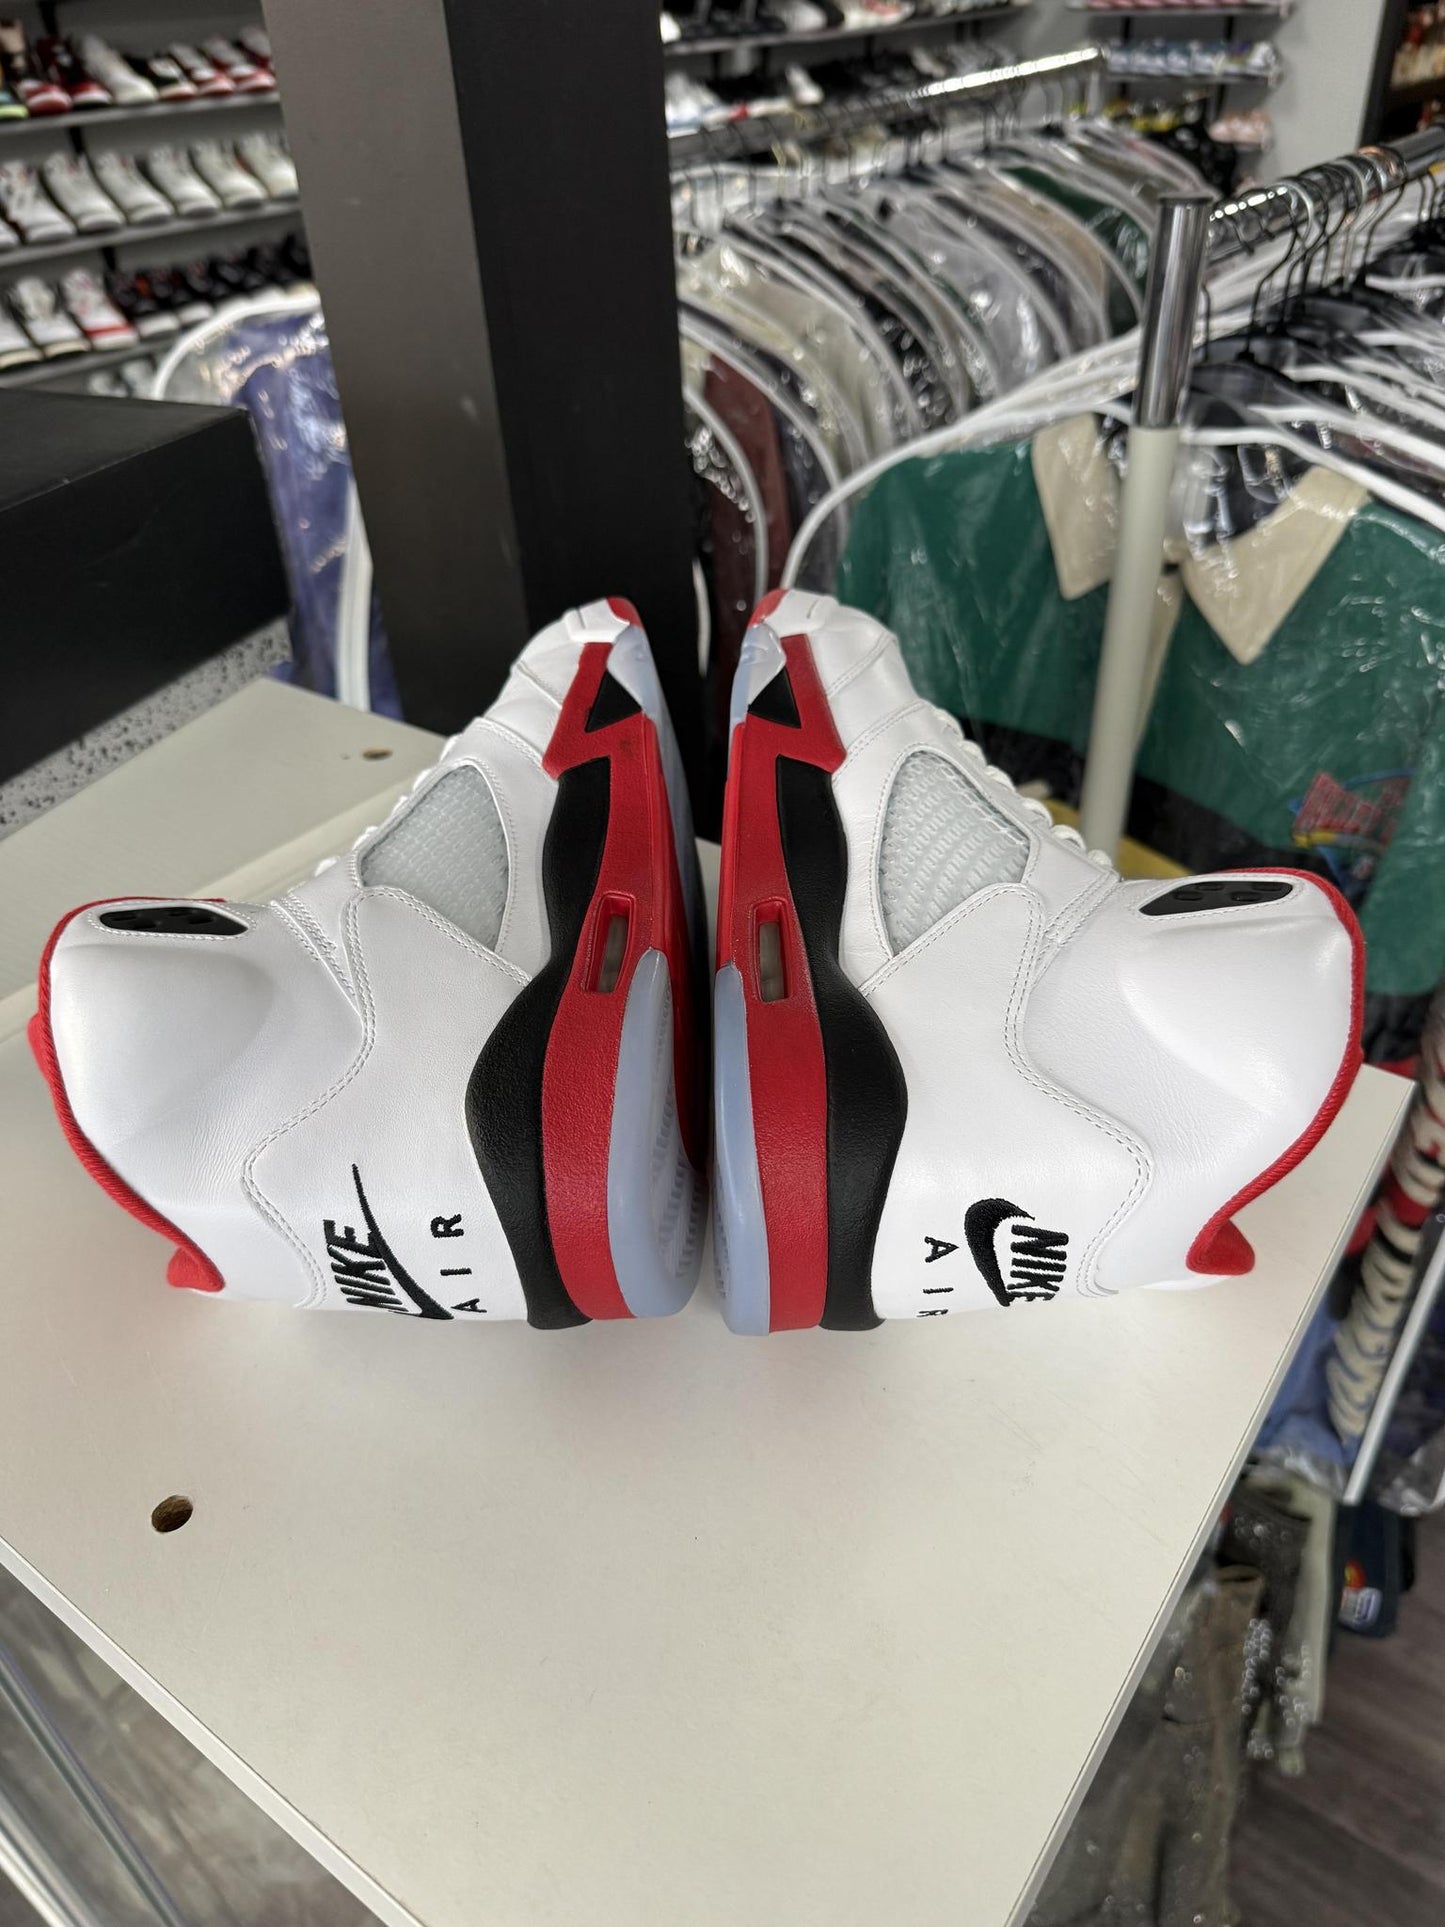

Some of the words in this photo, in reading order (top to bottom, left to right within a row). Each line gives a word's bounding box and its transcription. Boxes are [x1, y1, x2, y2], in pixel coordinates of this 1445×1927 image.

[323, 1219, 409, 1312] NIKE
[431, 1213, 487, 1313] AIR
[916, 1236, 959, 1317] AIR
[1005, 1224, 1069, 1302] NIKE
